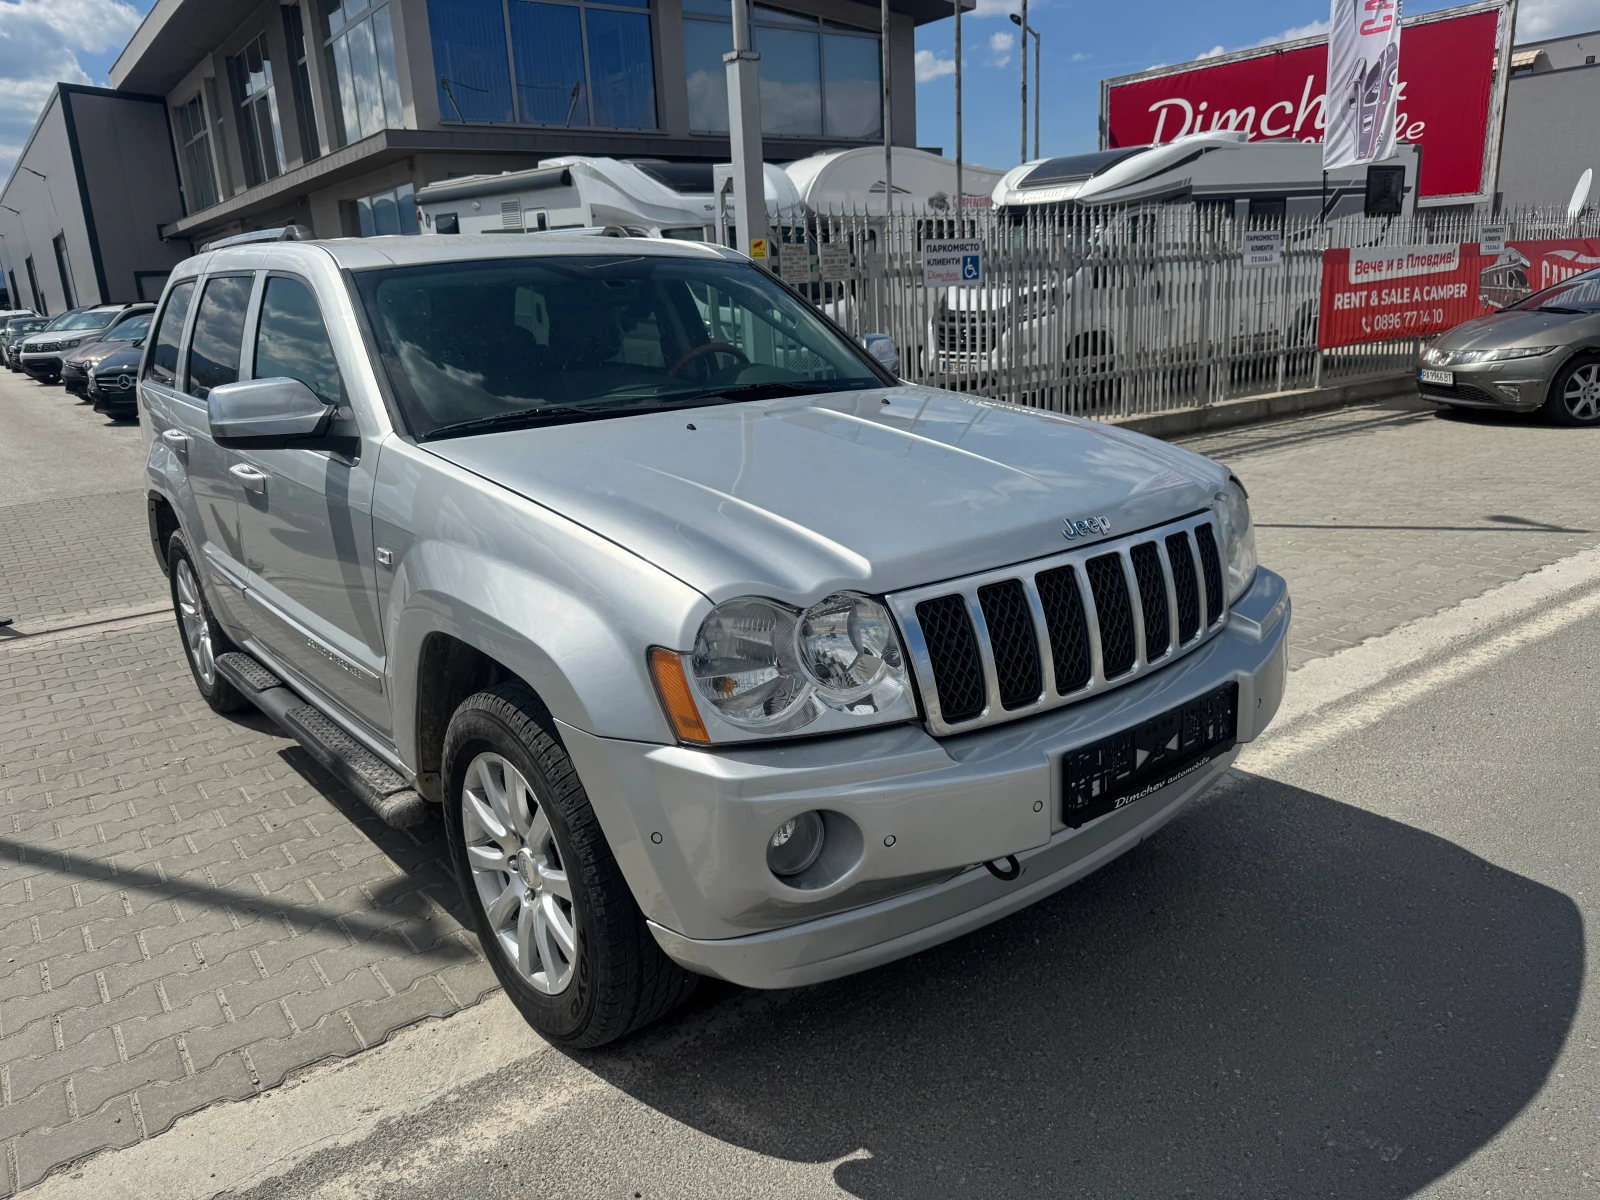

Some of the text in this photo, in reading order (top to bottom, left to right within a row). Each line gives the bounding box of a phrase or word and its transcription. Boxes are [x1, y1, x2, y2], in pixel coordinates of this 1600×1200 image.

[926, 243, 980, 253] ПАРКОМЯСТО
[1246, 234, 1279, 242] ПАРКОМЯСТО
[927, 258, 960, 266] КЛИЕНТИ
[1354, 249, 1456, 275] Вече и в Пловдив!
[1334, 283, 1467, 310] RENT & SALE A CAMPER
[1374, 308, 1443, 331] 0896 77 14 10
[1061, 515, 1111, 540] Jeep
[1114, 756, 1210, 809] Dimchev automobile
